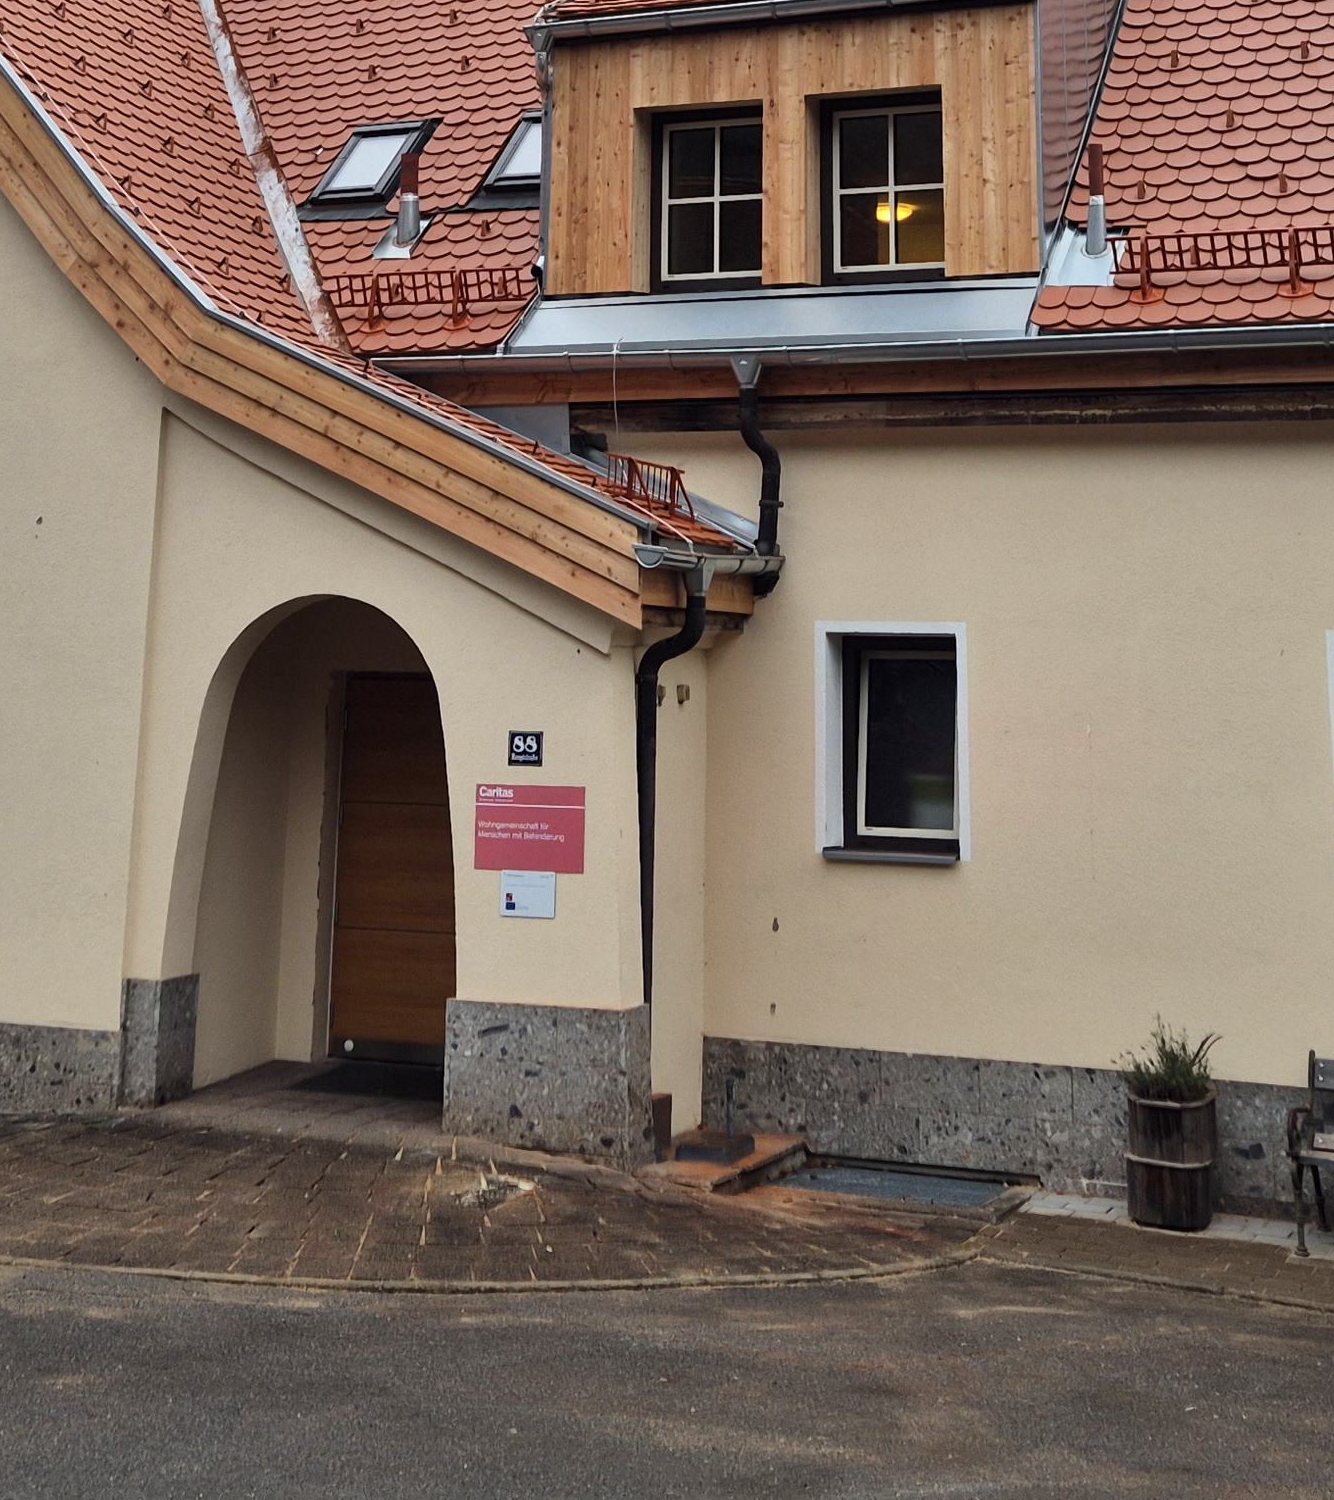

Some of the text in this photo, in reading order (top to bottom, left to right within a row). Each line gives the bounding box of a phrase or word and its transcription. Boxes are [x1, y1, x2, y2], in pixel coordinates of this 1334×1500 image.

[512, 735, 538, 753] 88
[479, 786, 514, 797] Caritas
[478, 820, 539, 830] Wohngemeinschaft
[478, 830, 510, 838] Menschen
